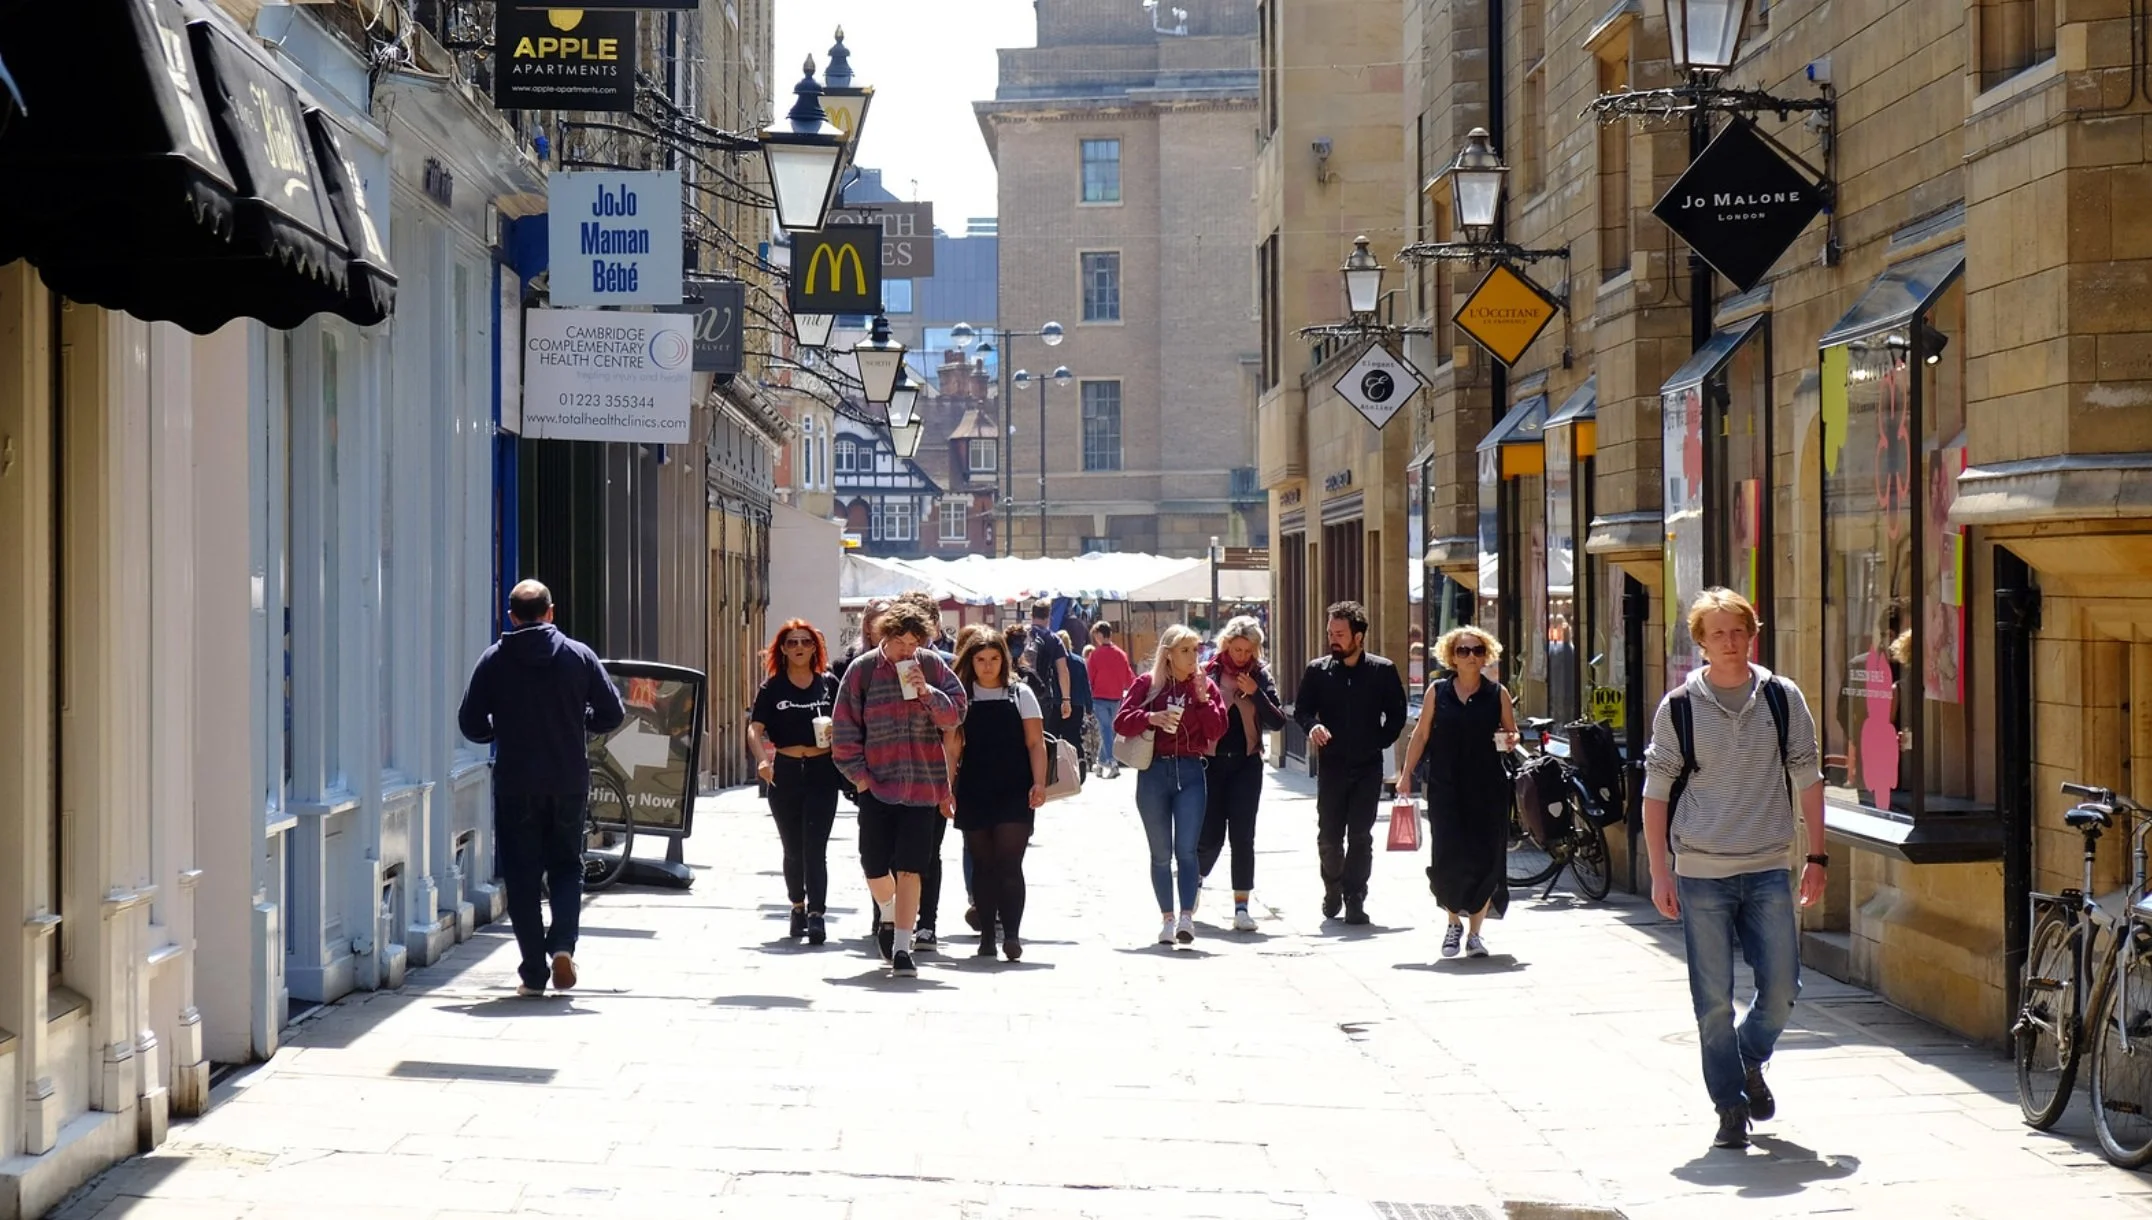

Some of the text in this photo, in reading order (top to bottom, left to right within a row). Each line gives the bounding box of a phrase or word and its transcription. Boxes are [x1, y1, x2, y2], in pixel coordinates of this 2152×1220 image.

[512, 36, 618, 60] APPLE
[511, 64, 617, 77] APARTMENTS
[512, 85, 617, 95] www.apple-apartments.com
[592, 183, 638, 217] JoJo
[581, 221, 650, 256] Maman
[592, 259, 638, 293] Bébé
[1470, 306, 1540, 318] L'OCCITANE
[566, 325, 645, 341] CAMBRIDGE
[528, 338, 645, 354] COMPLEMENTARY
[695, 343, 731, 351] VELVET
[540, 352, 644, 368] HEALTH CENTRE
[1361, 360, 1395, 368] Elegant
[640, 372, 658, 381] and
[559, 393, 655, 409] 01223 355344
[526, 413, 687, 429] www.totalhealthclinics.com
[1596, 690, 1622, 705] 100
[639, 792, 676, 809] Now
